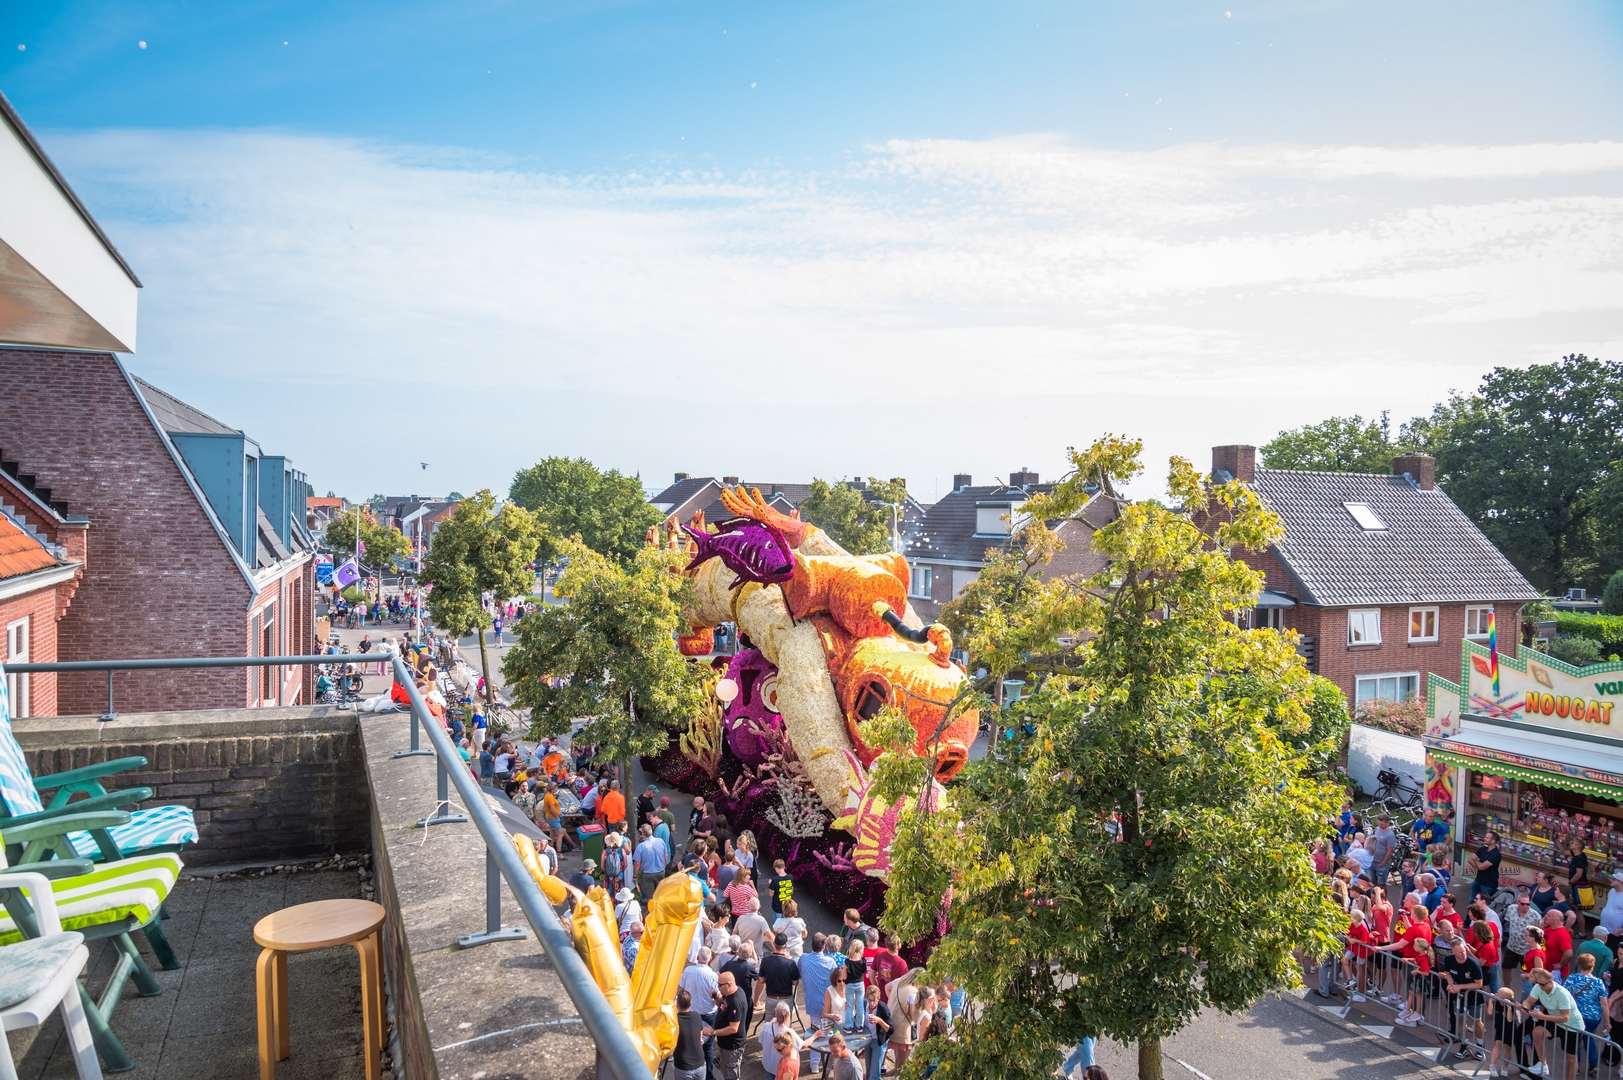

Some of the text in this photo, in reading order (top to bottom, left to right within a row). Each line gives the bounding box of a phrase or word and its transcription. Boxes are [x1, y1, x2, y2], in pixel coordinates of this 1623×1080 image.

[1525, 691, 1614, 724] NOUGAT
[1441, 742, 1472, 755] JOHAN
[1475, 748, 1493, 759] VAN
